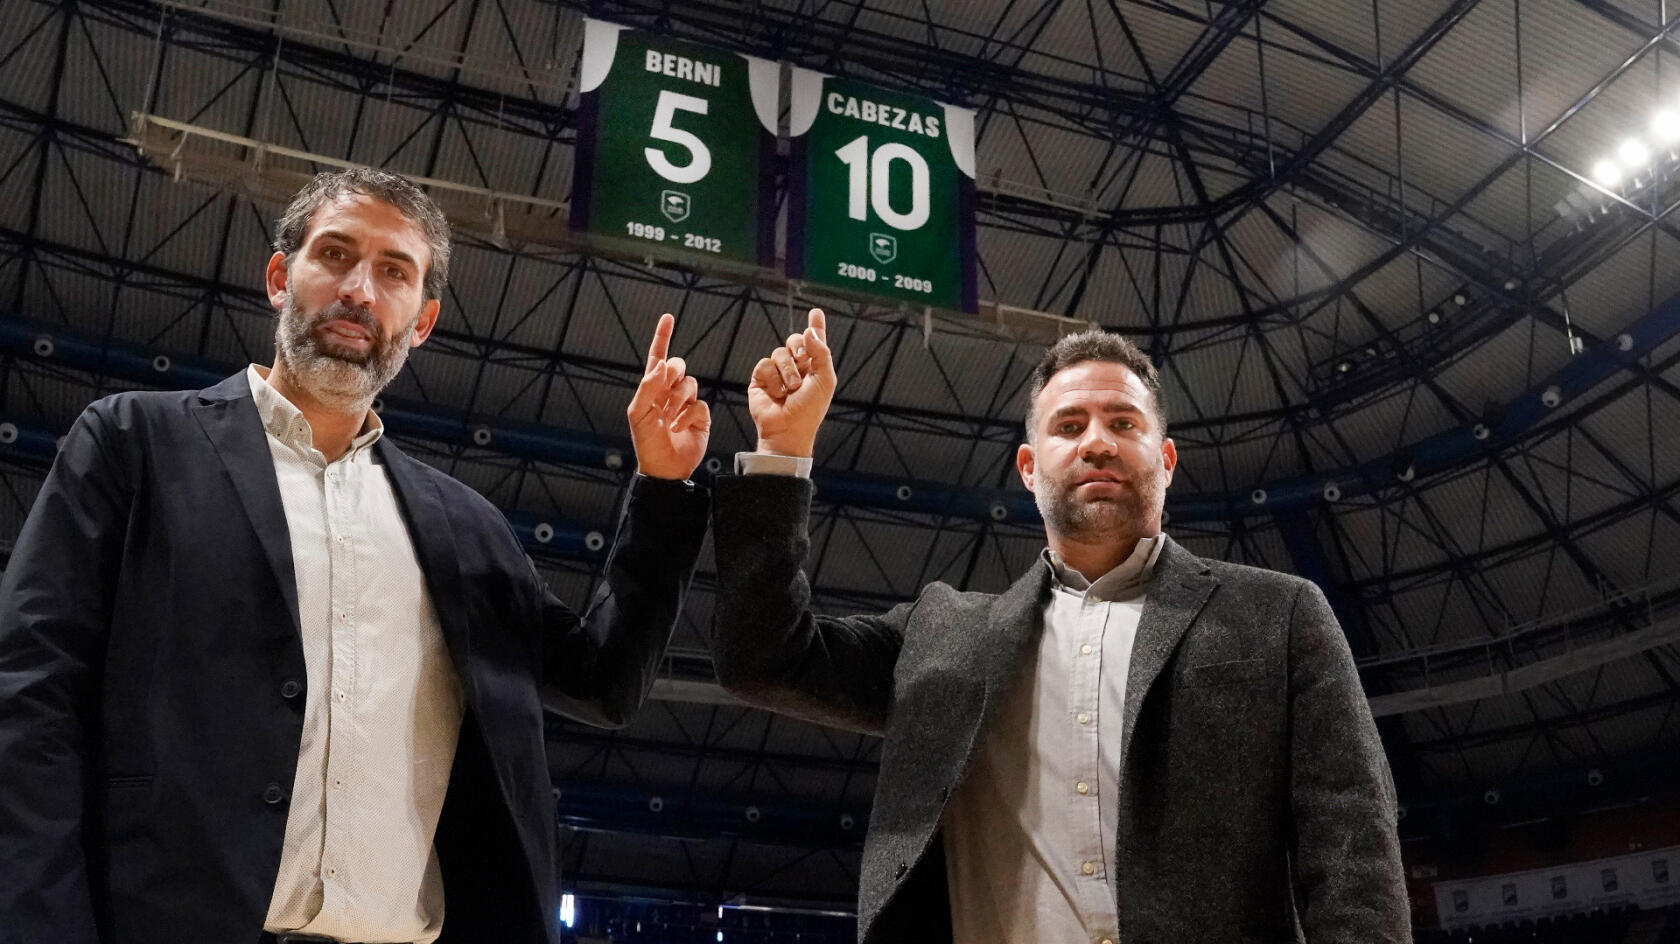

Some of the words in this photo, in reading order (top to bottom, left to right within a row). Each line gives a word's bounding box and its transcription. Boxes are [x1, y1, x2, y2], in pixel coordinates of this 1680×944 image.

[645, 49, 721, 87] BERNI
[827, 92, 940, 138] CABEZAS
[644, 89, 712, 184] 5
[834, 135, 931, 231] 10
[626, 221, 665, 241] 1999
[684, 232, 722, 253] 2012
[838, 262, 877, 282] 2000
[894, 274, 933, 293] 2009
